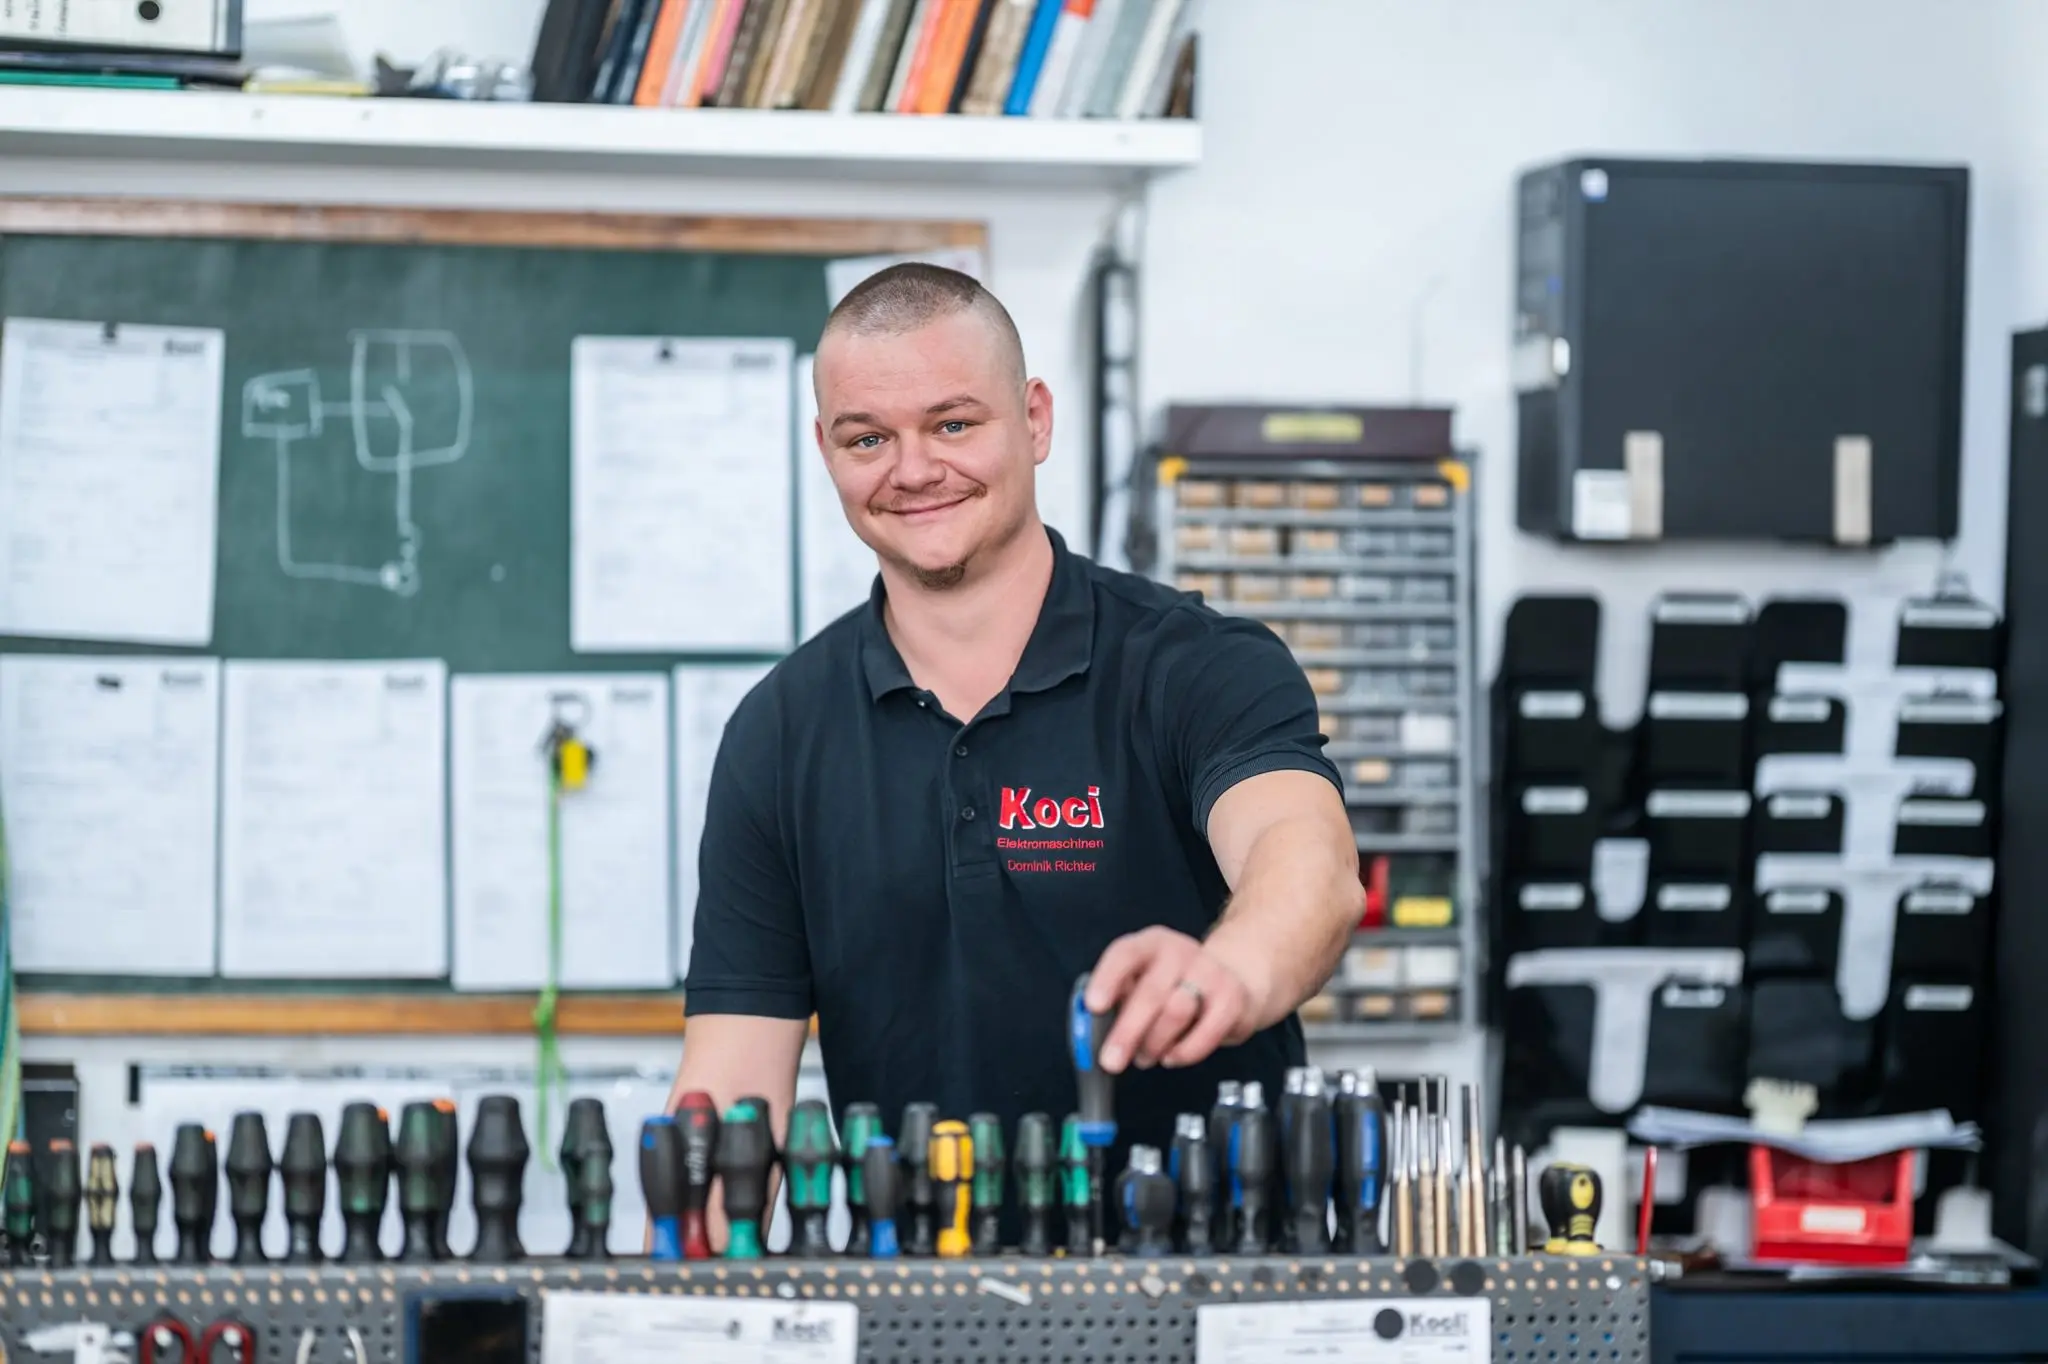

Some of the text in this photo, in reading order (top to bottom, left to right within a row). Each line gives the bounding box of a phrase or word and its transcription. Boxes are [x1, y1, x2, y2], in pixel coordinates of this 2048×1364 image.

[999, 785, 1104, 829] Koci
[997, 837, 1104, 849] Elektromaschinen
[1007, 860, 1097, 872] Dominik Richter
